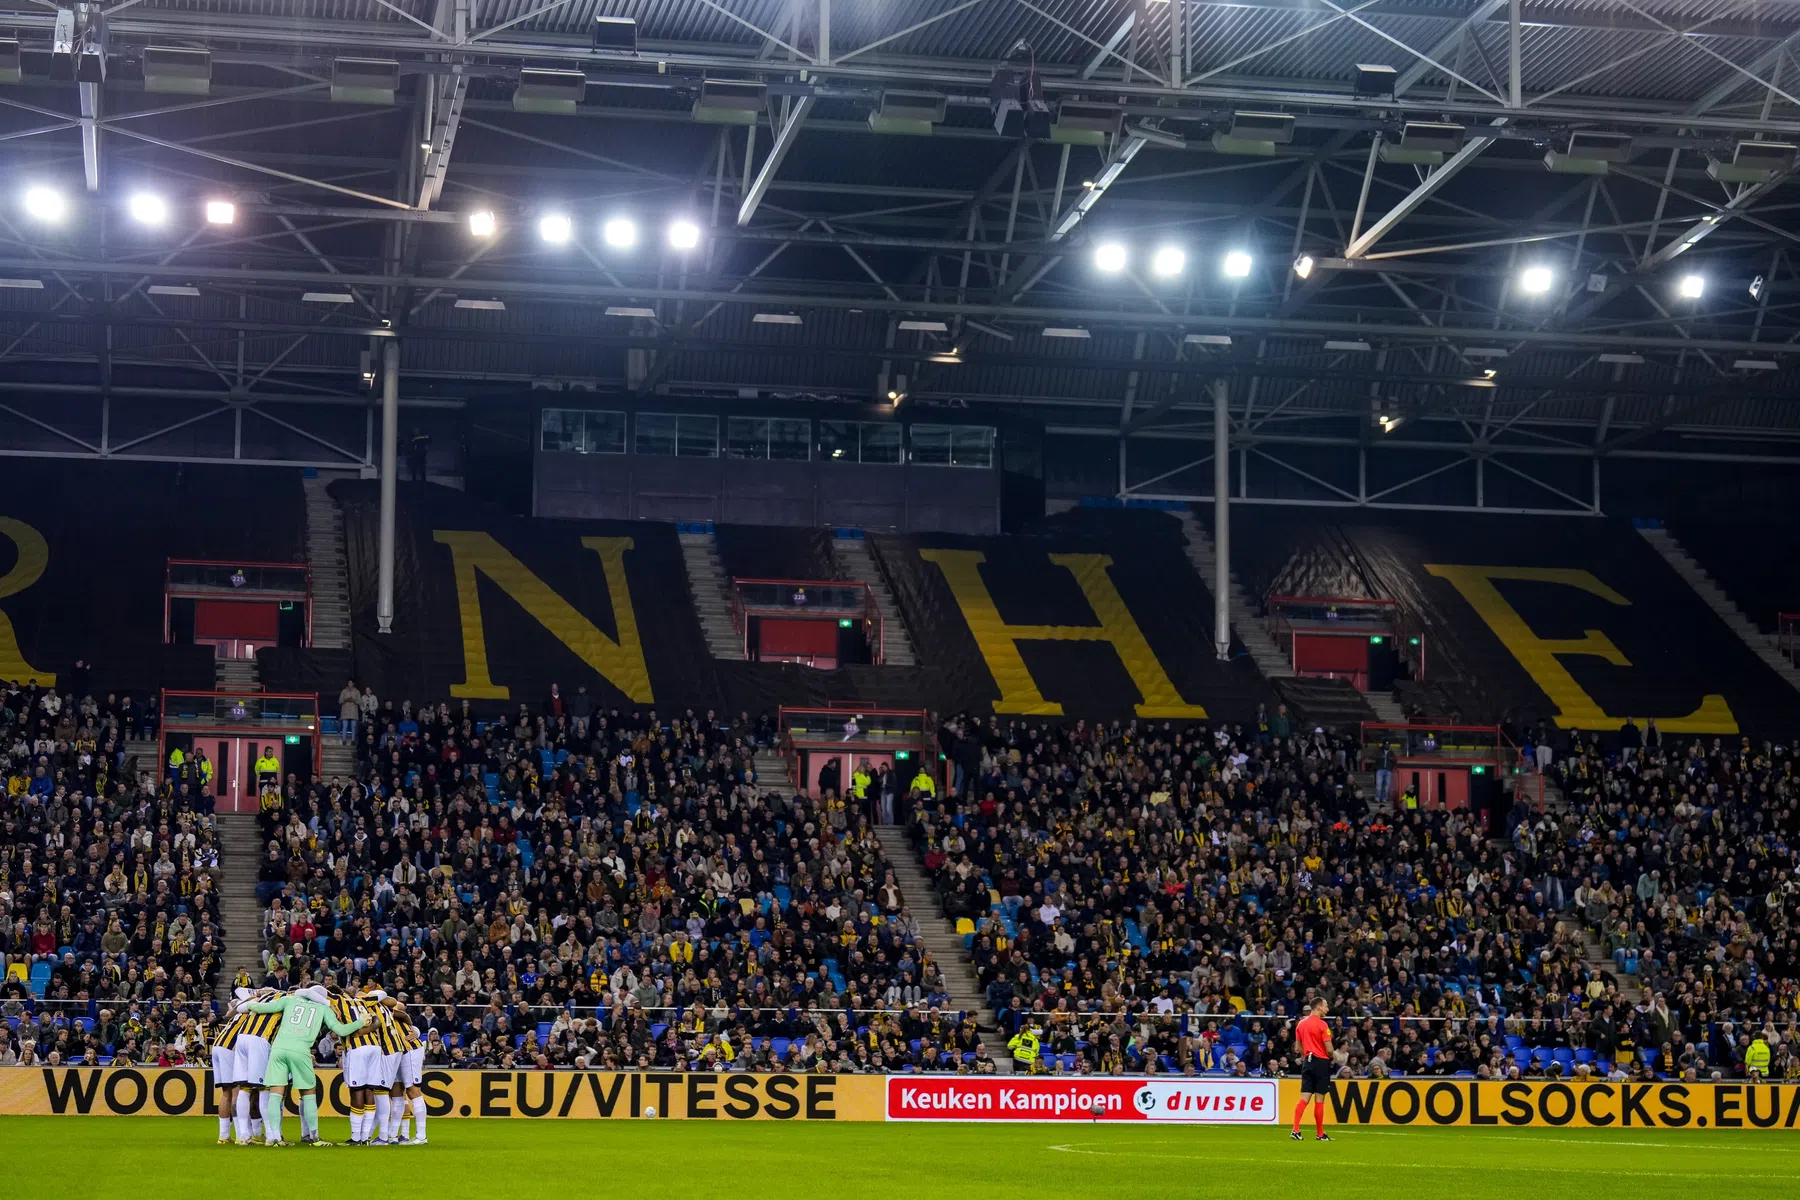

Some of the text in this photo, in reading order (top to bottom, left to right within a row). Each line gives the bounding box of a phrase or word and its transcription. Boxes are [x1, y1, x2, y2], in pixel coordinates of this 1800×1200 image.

[290, 1005, 316, 1028] 31
[43, 1067, 836, 1120] WOOLOCS.EU/VITESSE
[901, 1087, 1264, 1115] Keuken Kampioen divisie
